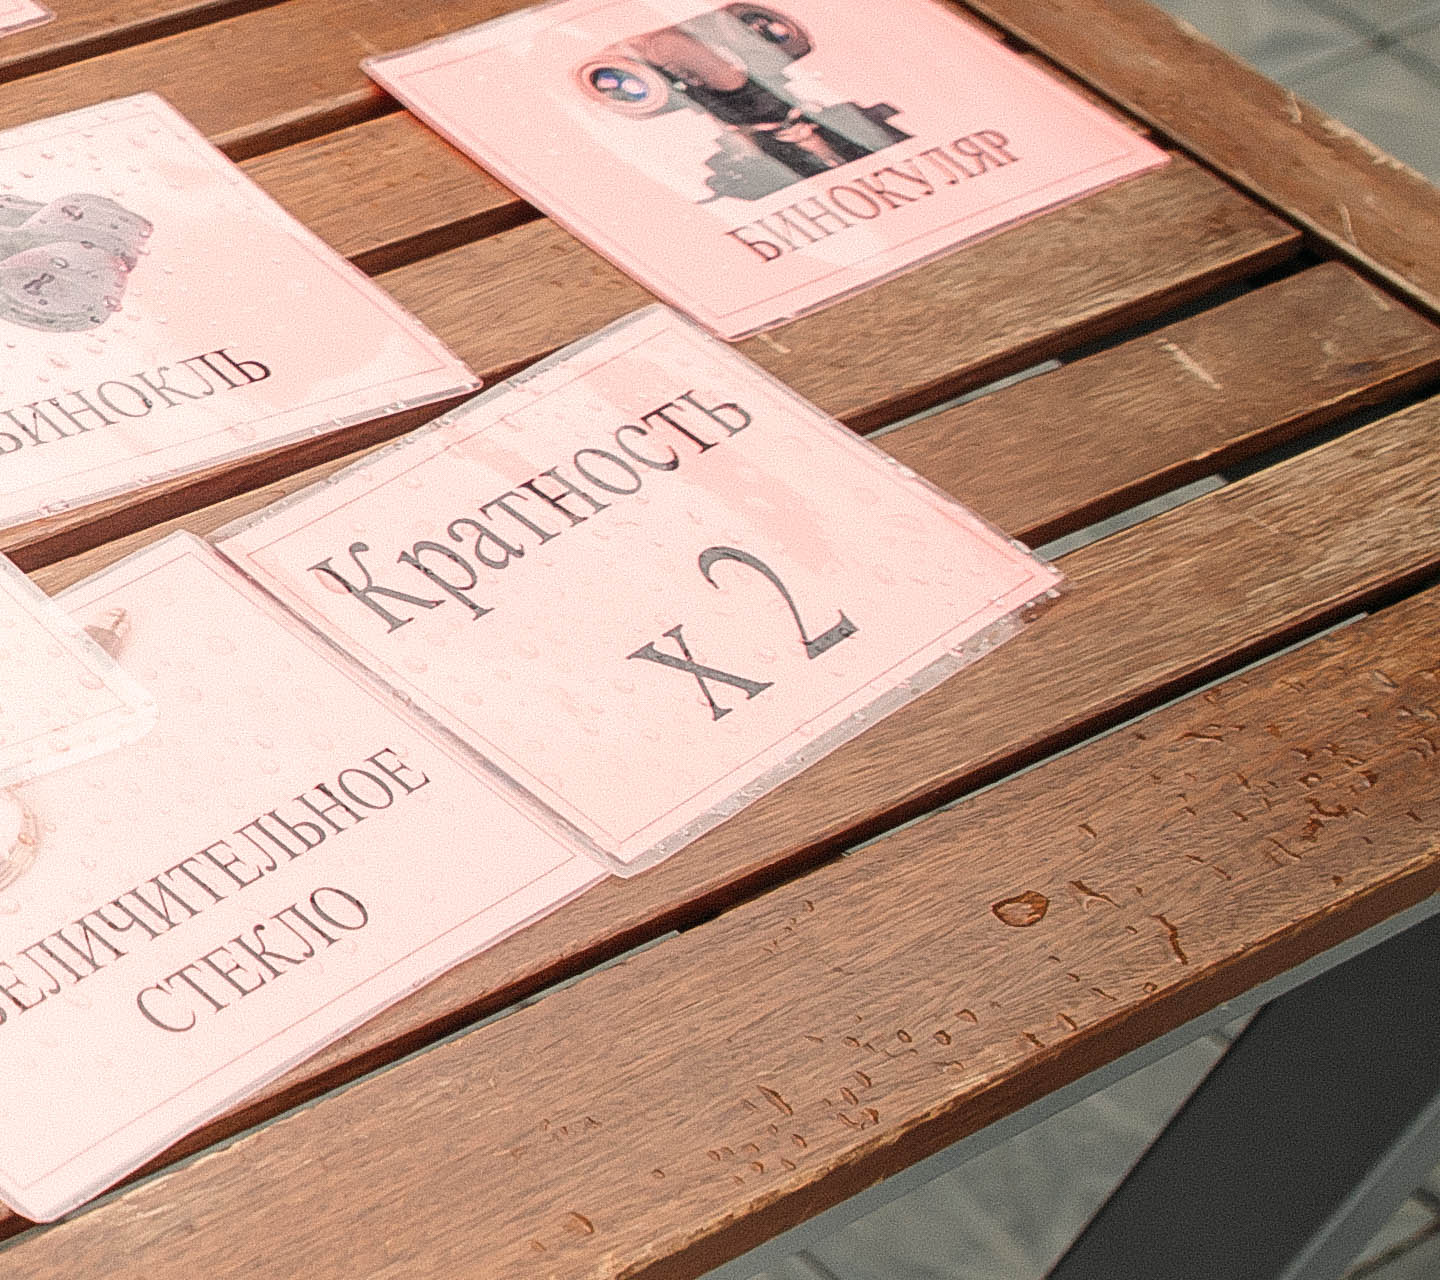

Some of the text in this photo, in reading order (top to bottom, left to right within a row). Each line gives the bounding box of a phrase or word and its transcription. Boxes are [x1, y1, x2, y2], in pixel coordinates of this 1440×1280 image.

[726, 129, 1020, 264] БИНОКУЛЯР
[307, 389, 755, 634] Кратность
[697, 545, 861, 660] 2
[135, 885, 371, 1034] СТЕКЛО
